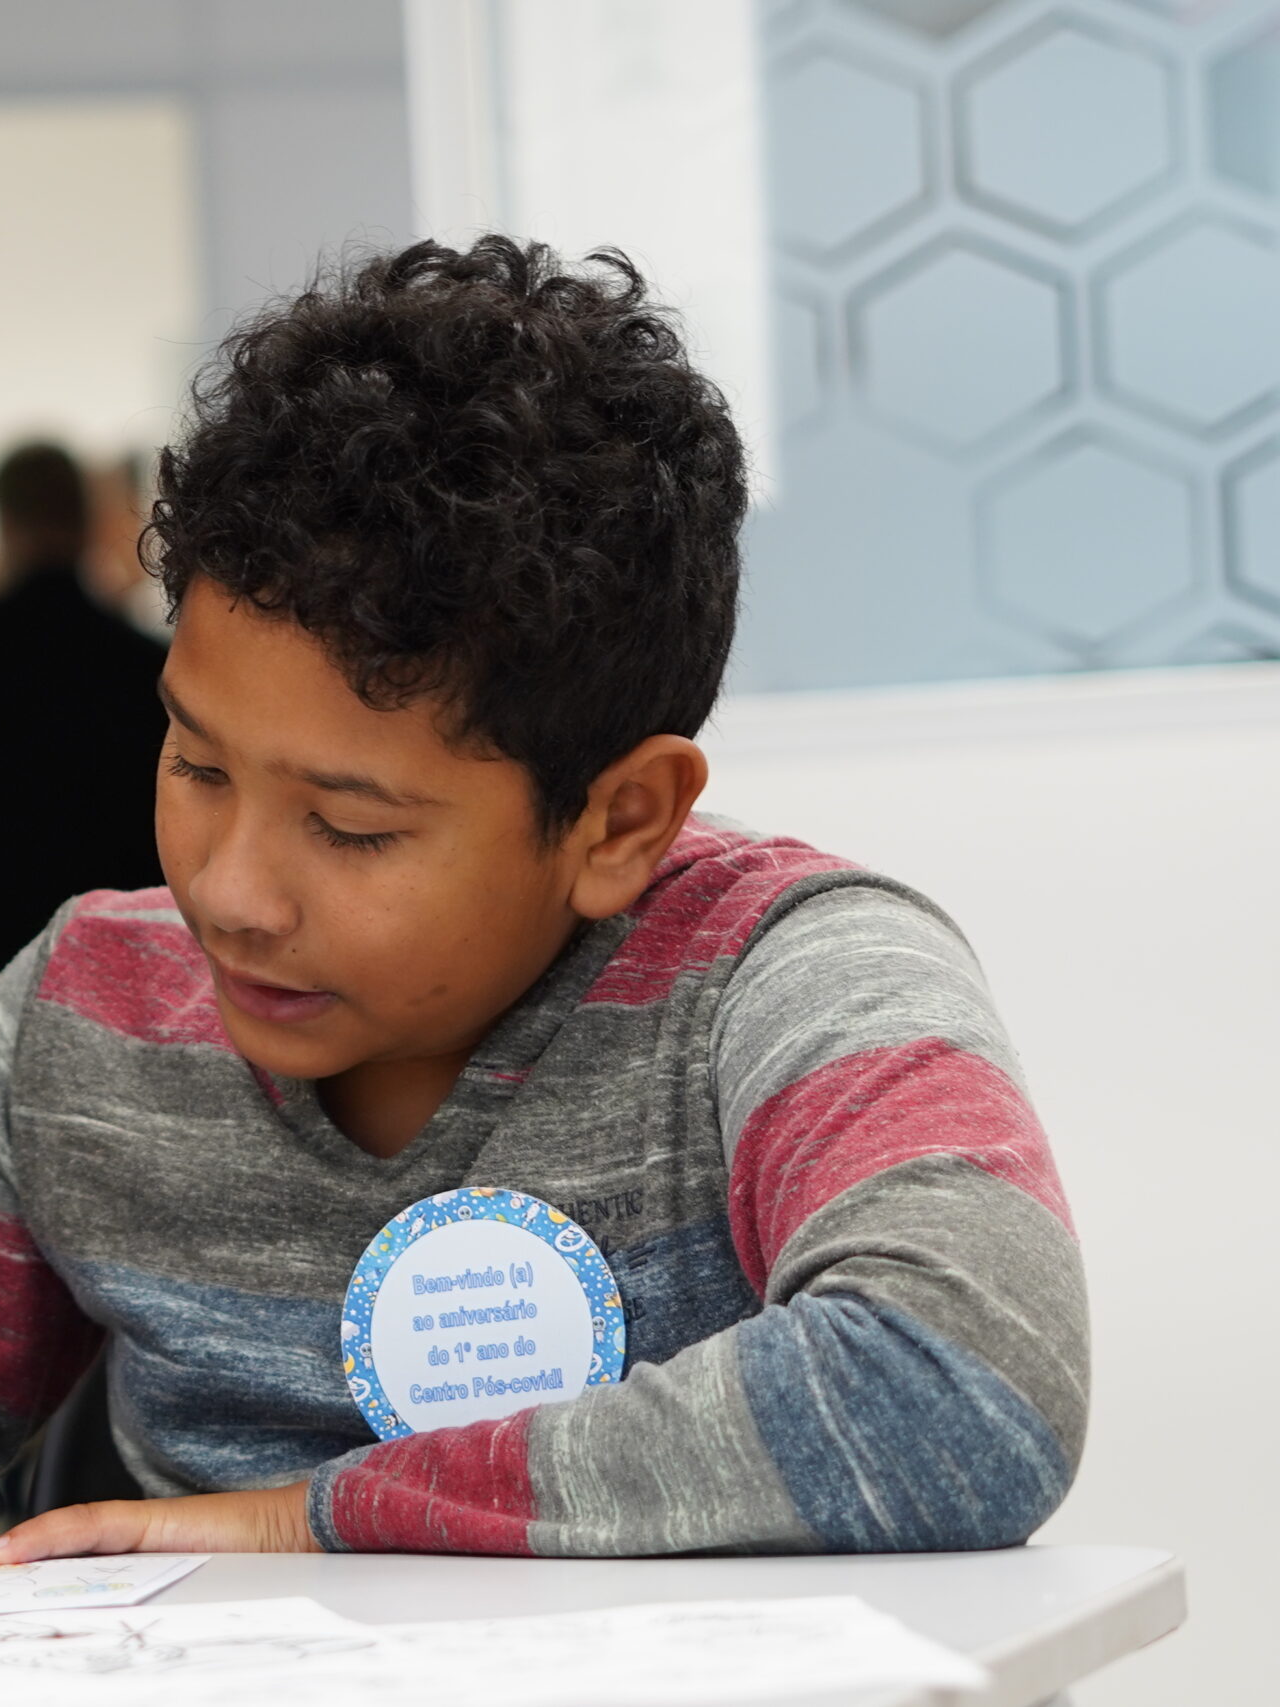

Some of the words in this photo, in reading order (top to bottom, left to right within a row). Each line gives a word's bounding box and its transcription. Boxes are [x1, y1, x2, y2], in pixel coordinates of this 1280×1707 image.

[412, 1266, 505, 1295] Bem-vindo
[509, 1261, 534, 1289] (a)
[412, 1314, 434, 1331] ao
[439, 1299, 537, 1329] aniversário
[428, 1345, 450, 1366] do
[476, 1343, 509, 1361] ano
[514, 1335, 536, 1356] do
[410, 1382, 468, 1404] Centro
[472, 1368, 564, 1397] Pós-covid!
